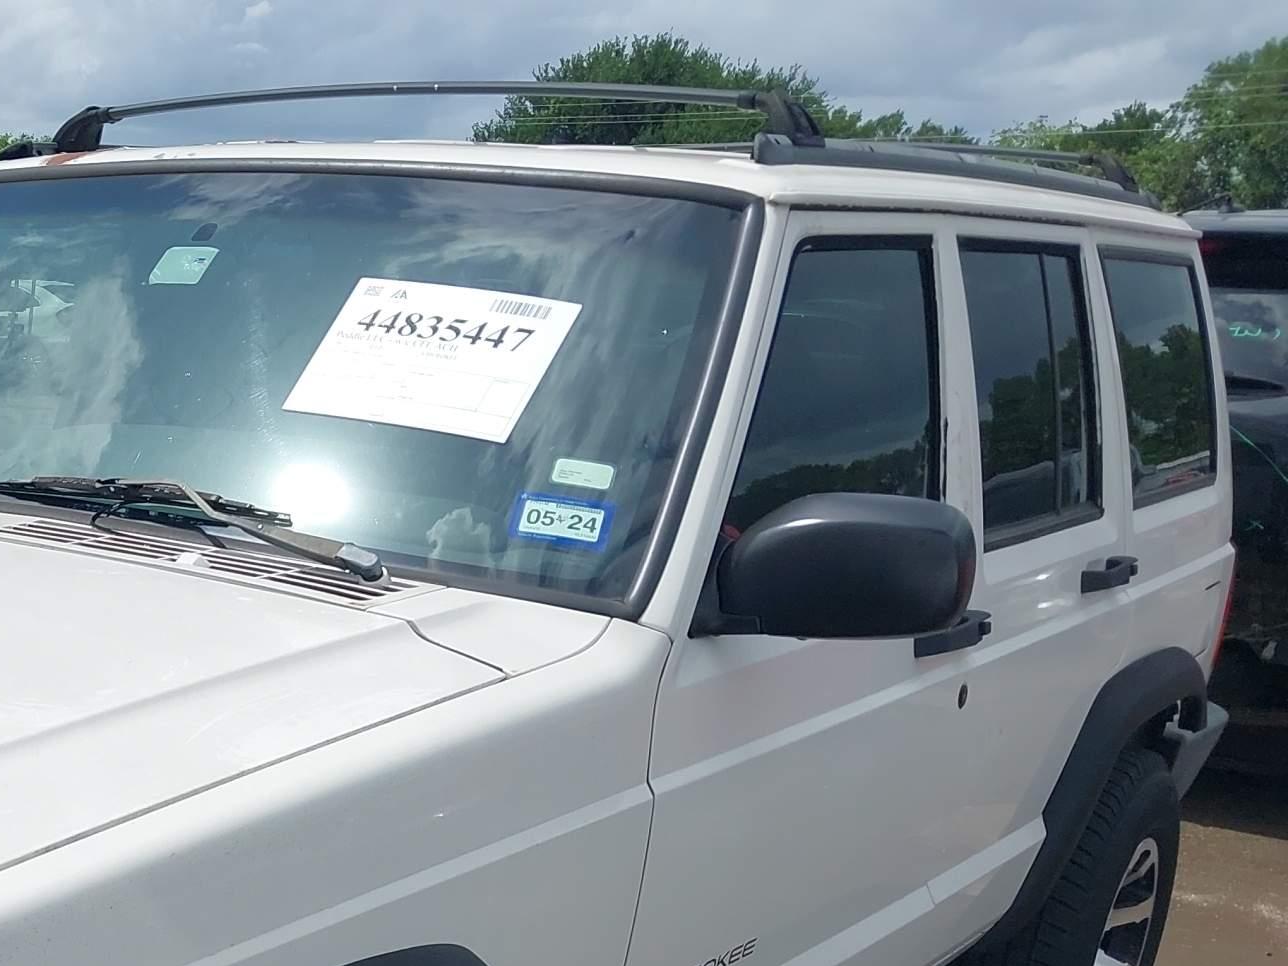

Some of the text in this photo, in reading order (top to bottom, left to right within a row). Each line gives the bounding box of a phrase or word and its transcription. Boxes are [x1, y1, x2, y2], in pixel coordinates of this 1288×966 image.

[358, 308, 535, 352] 44835447
[526, 508, 597, 533] 05 24
